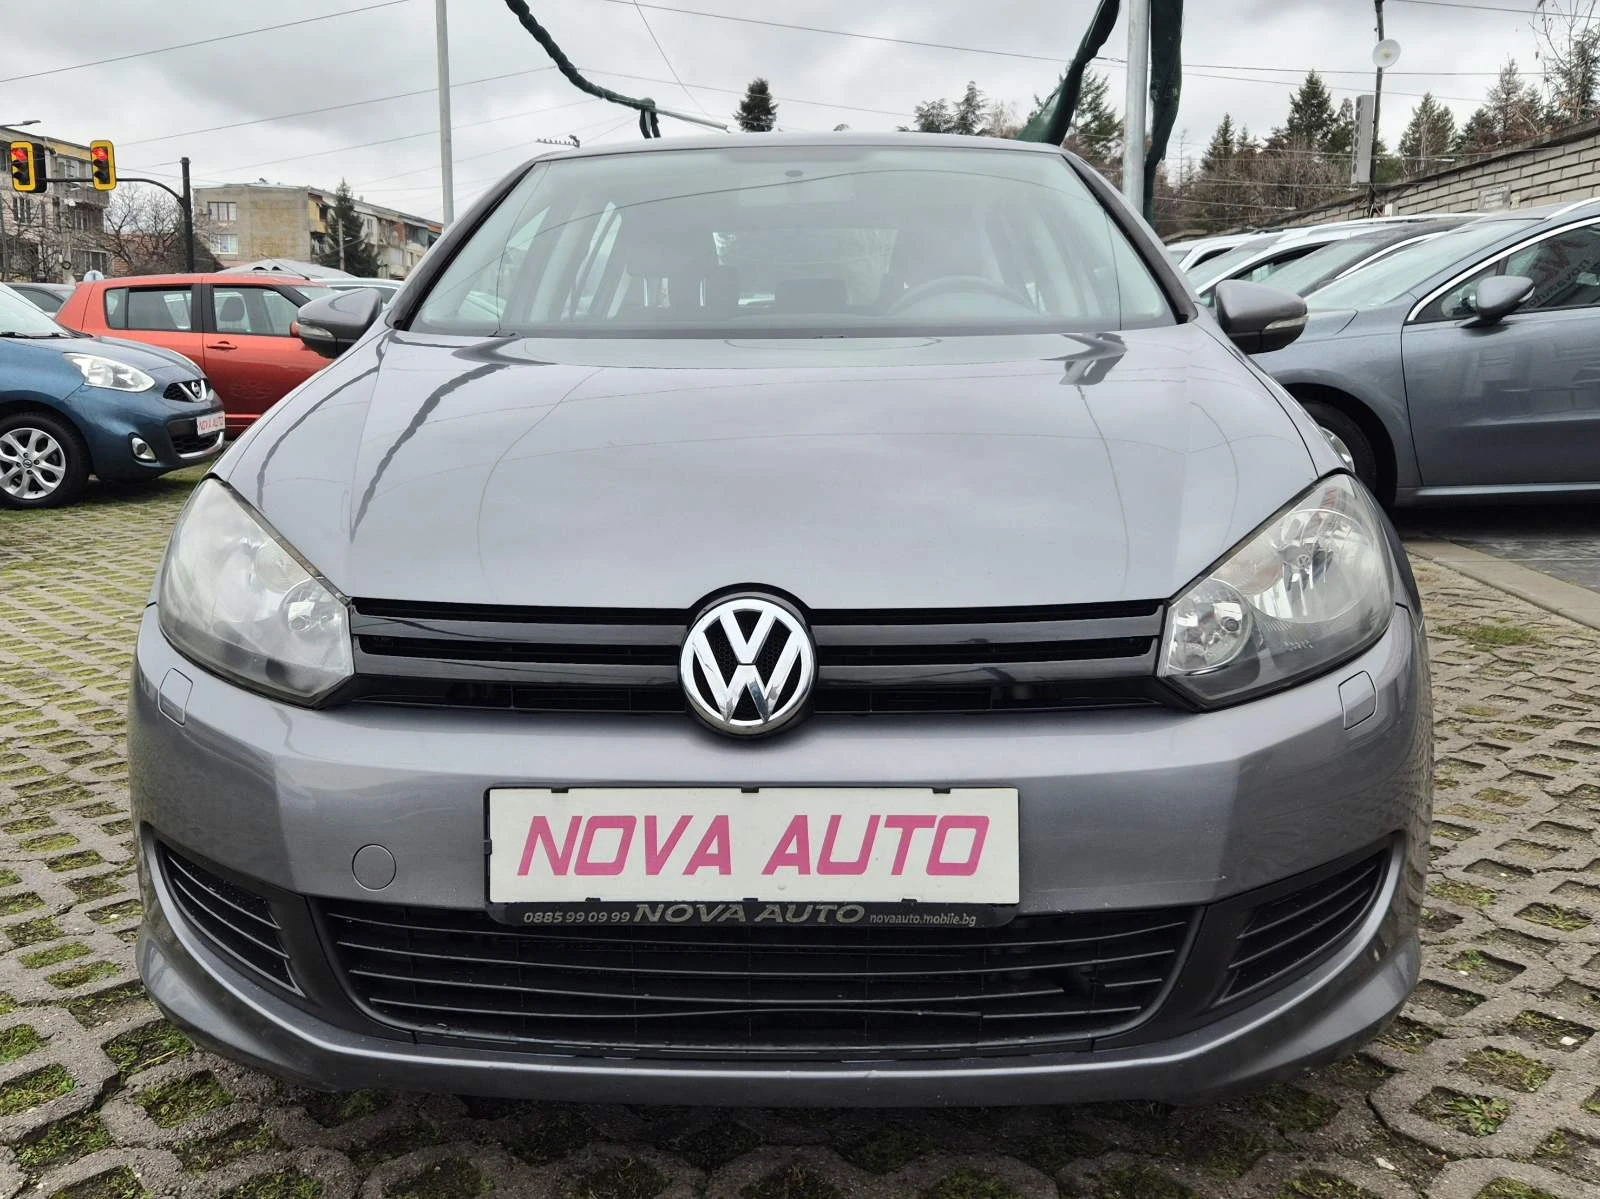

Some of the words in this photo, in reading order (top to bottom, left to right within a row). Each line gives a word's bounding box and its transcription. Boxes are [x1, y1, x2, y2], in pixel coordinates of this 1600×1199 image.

[518, 815, 733, 876] NOVA
[761, 815, 989, 876] AUTO
[523, 911, 563, 924] 0885
[565, 911, 586, 923] 99
[588, 911, 608, 923] 09
[611, 911, 631, 923] 99
[632, 903, 747, 923] NOVA
[754, 903, 866, 923] AUTO
